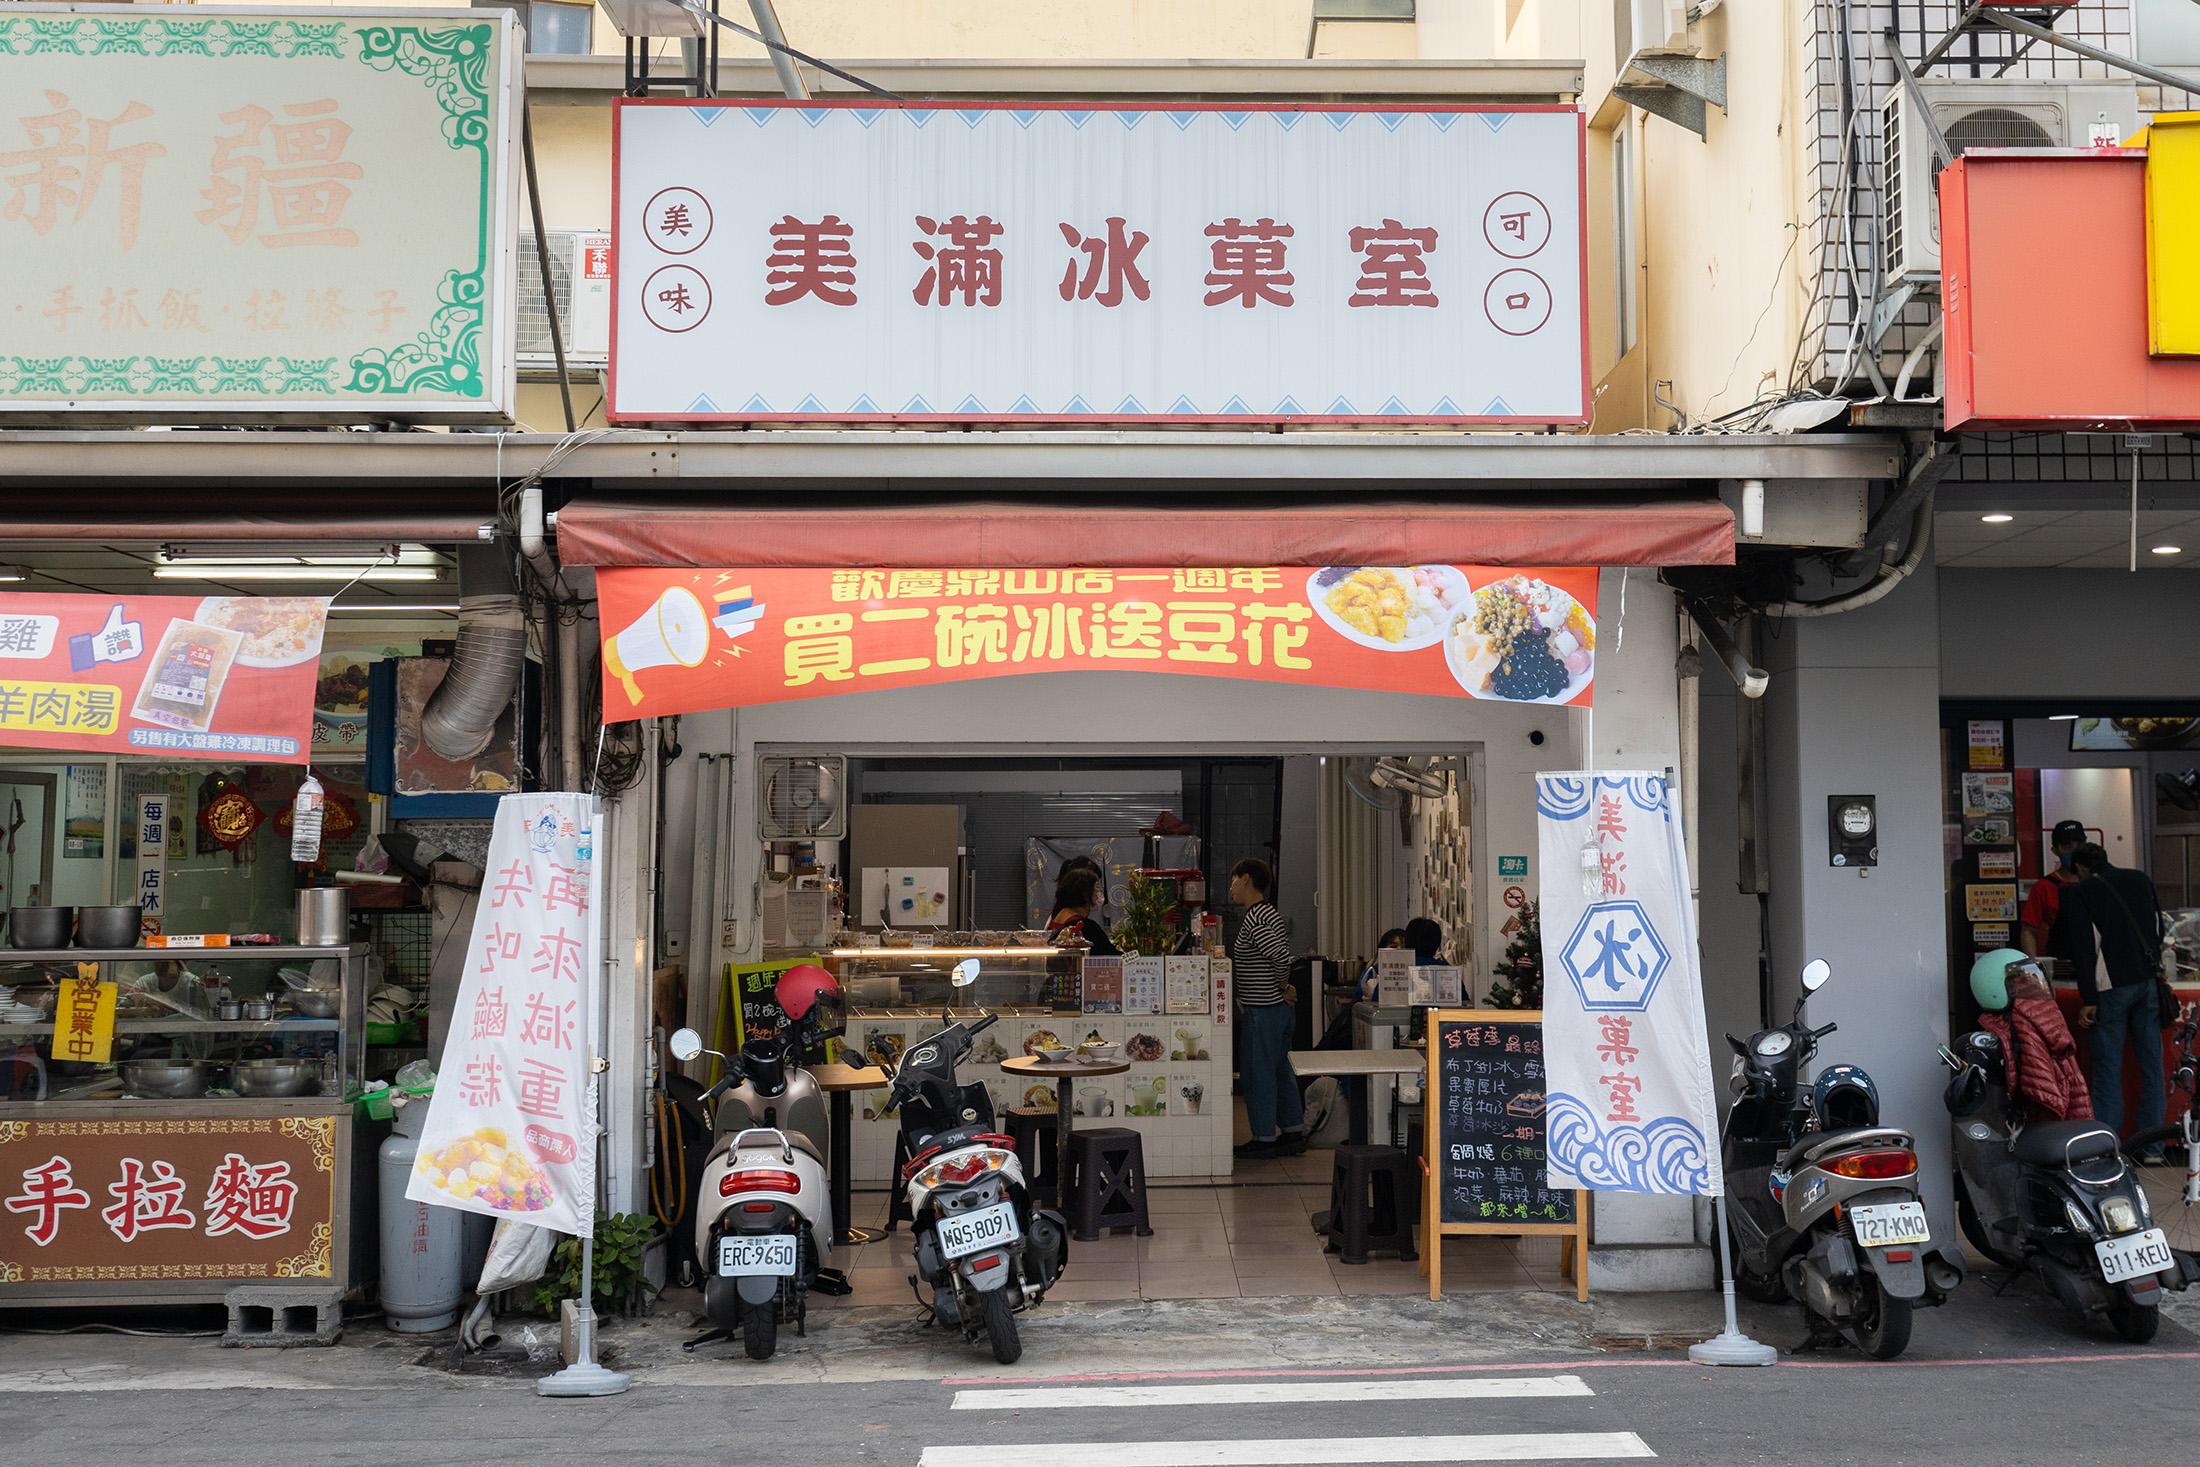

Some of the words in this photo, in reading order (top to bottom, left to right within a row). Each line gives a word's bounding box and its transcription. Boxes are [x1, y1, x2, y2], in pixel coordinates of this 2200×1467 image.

[0, 89, 364, 252] 新疆
[592, 249, 607, 274] 禾聯
[764, 215, 1438, 309] 美滿冰菓室
[831, 568, 1284, 602] 歡慶鼎山店一週年
[0, 619, 41, 652] 雞
[783, 602, 1312, 685] 買二碗冰送豆花
[0, 686, 116, 729] 羊肉湯
[132, 730, 295, 754] 另售有大盤雞冷凍調理包
[141, 801, 163, 911] 每週一店休
[69, 980, 102, 1060] 營業中
[1216, 979, 1226, 1024] 請先付款
[947, 1132, 966, 1145] SYM
[4, 1153, 299, 1246] 手拉麵
